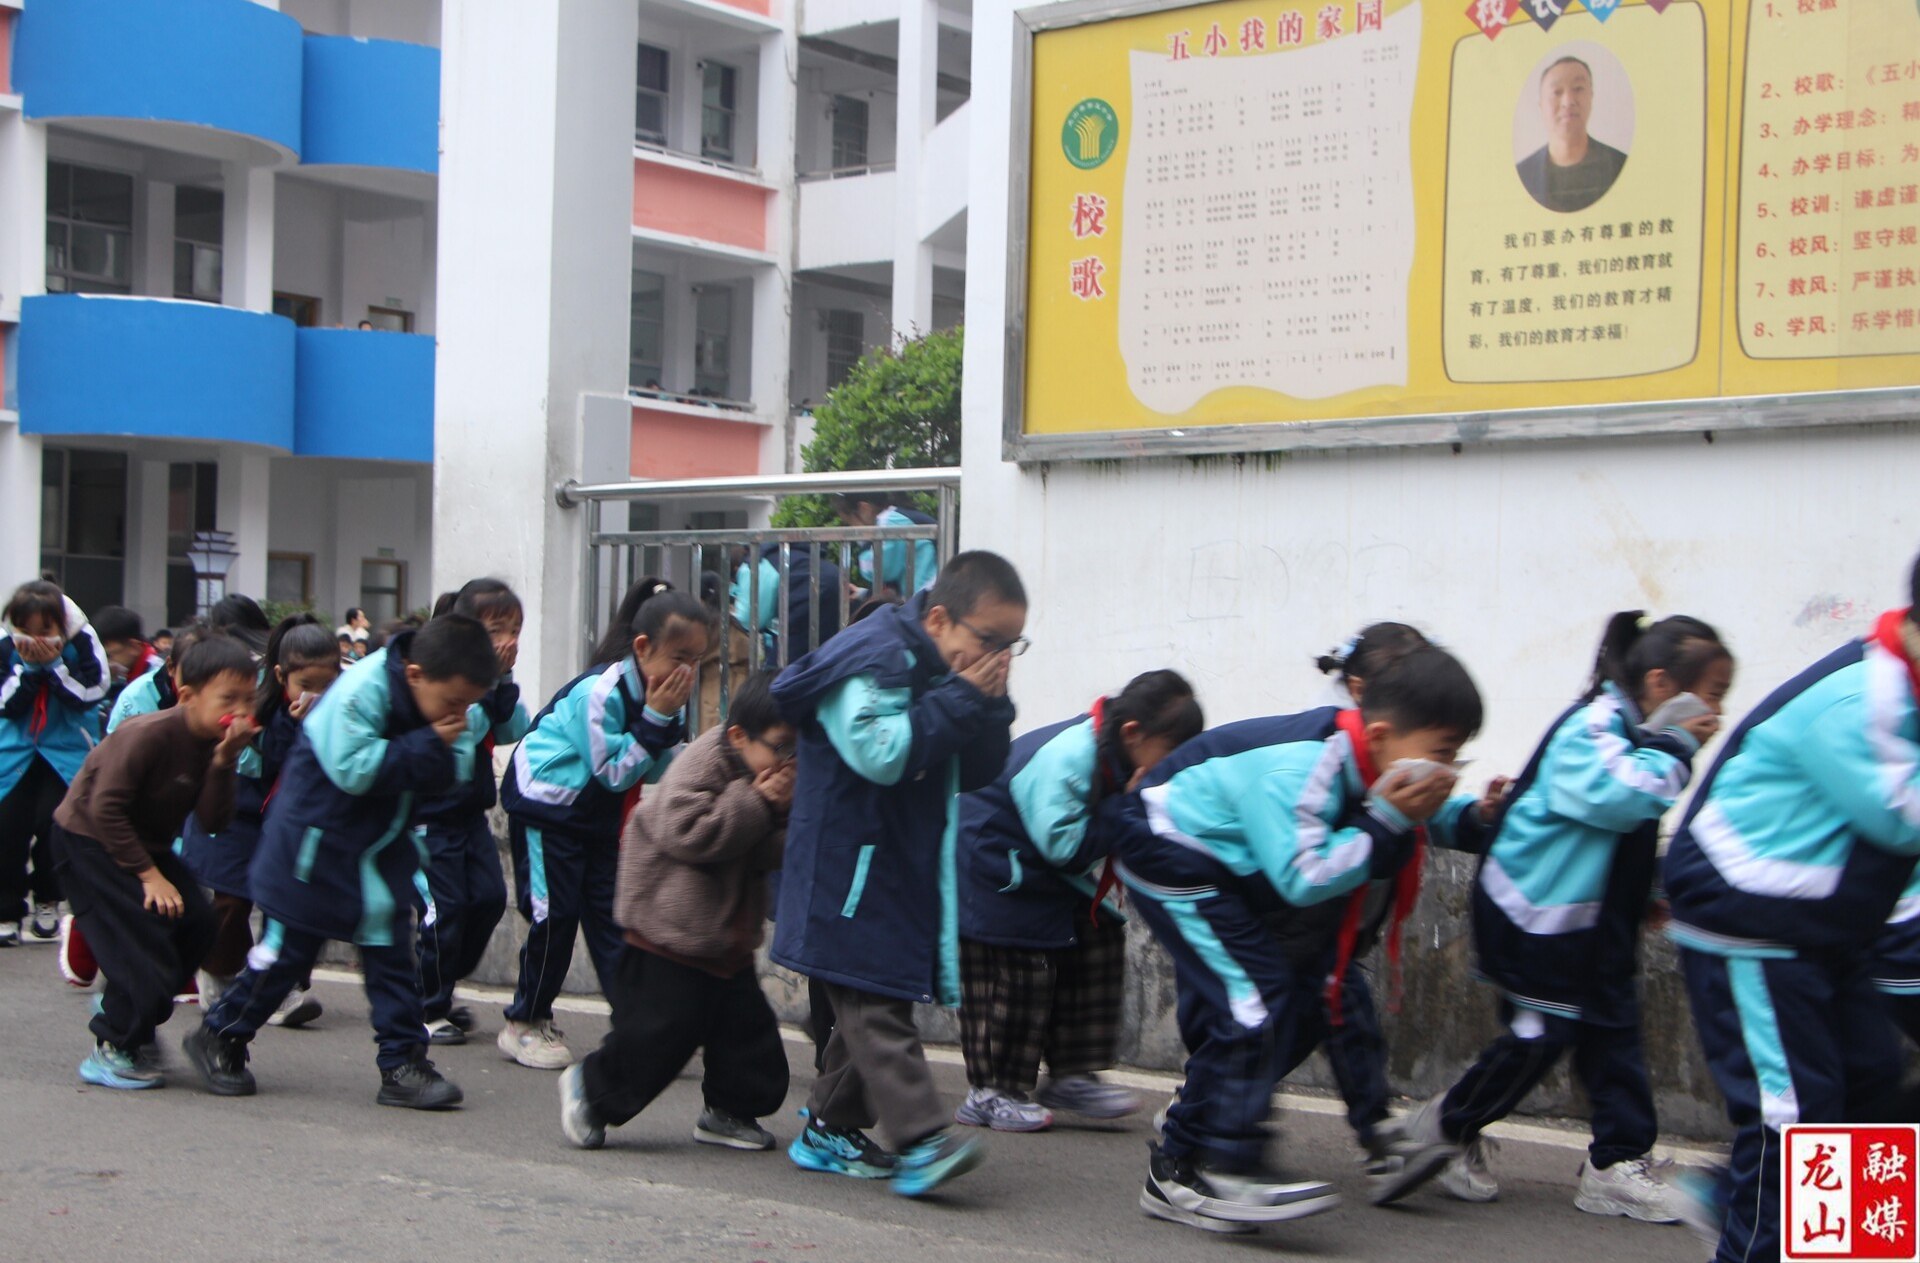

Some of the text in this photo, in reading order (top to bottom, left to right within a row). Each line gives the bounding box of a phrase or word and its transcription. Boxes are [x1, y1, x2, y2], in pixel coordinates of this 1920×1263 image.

[1167, 0, 1382, 61] 五小我的家园
[1072, 195, 1105, 299] 校歌
[1504, 218, 1674, 249] 我们要办有尊重的教
[1755, 267, 1920, 298] 7、教风：严谨执
[1754, 308, 1920, 337] 8、学风：乐学惜
